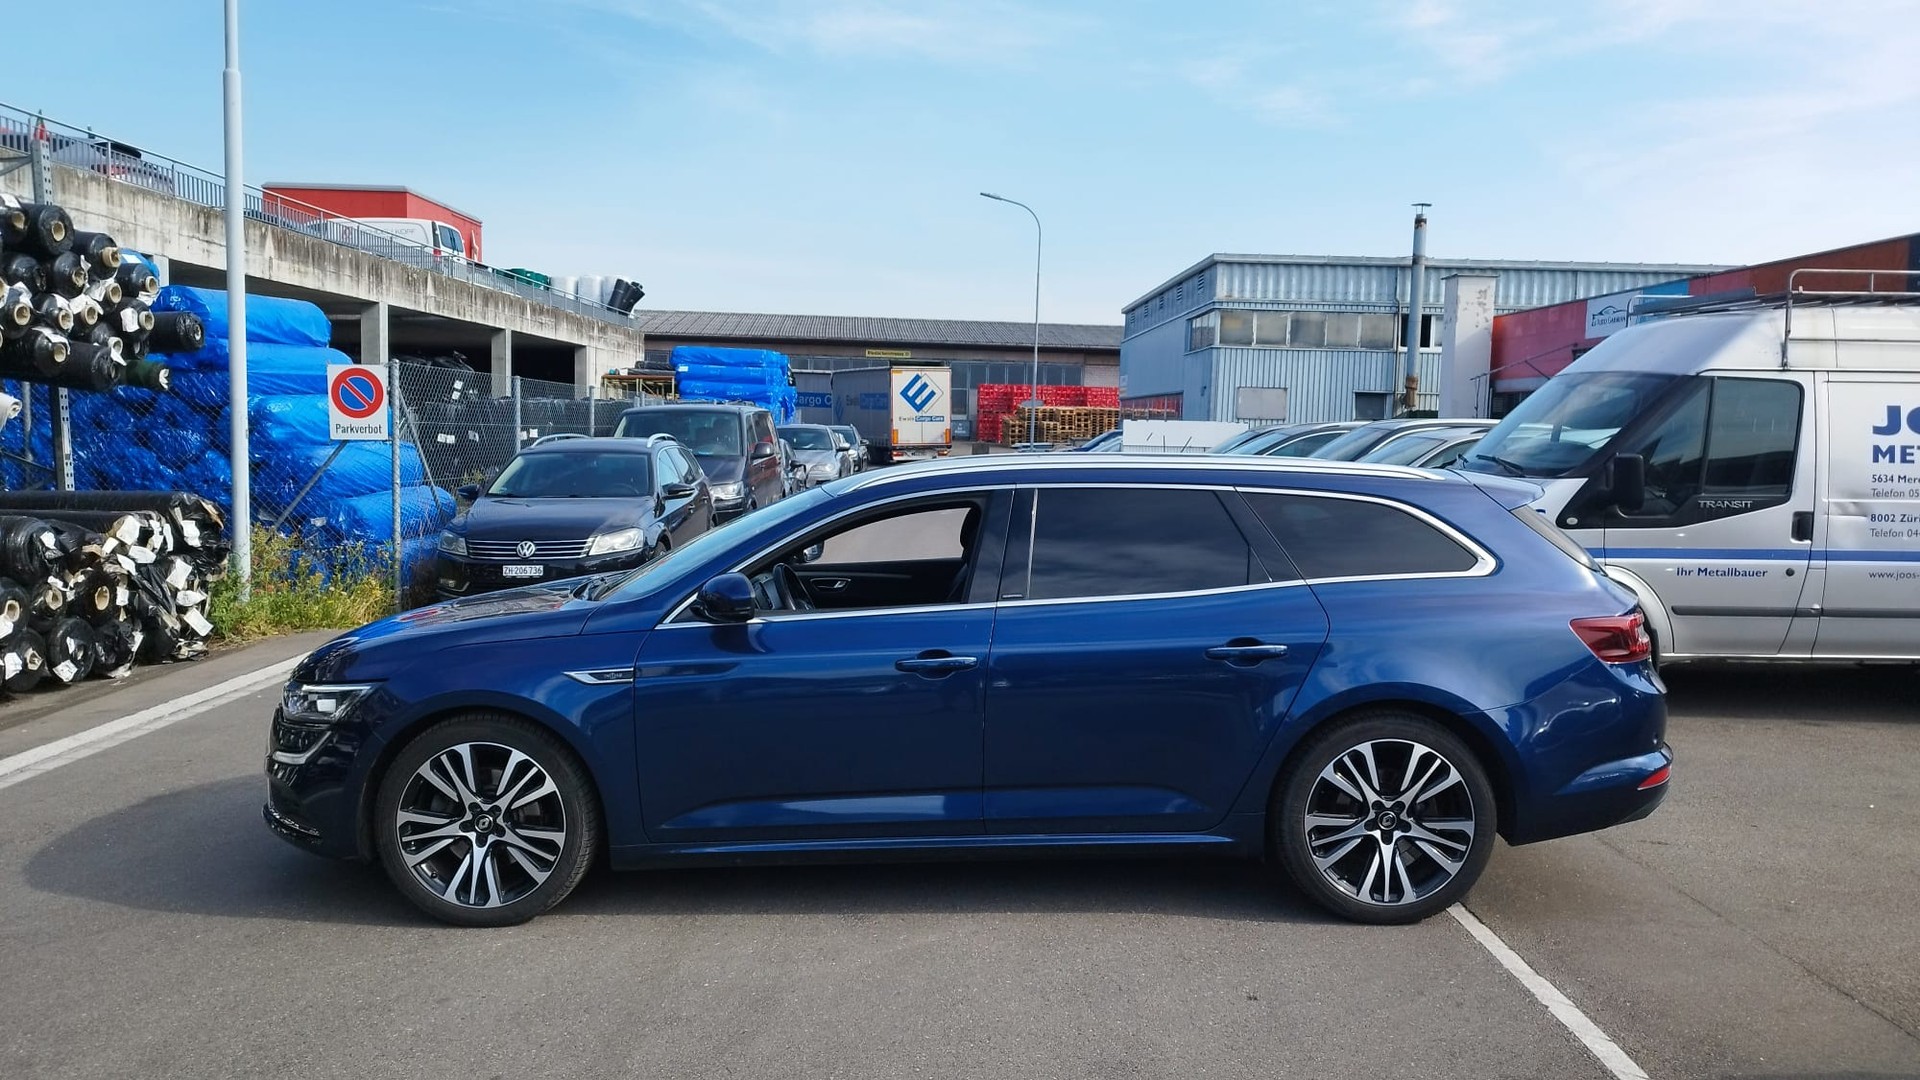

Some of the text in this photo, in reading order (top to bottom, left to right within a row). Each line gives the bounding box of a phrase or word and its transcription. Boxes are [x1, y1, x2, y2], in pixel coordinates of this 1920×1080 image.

[335, 423, 382, 434] Parkverbot
[1871, 474, 1894, 483] 5634
[1871, 488, 1905, 497] Telefon
[1698, 500, 1753, 509] TRANSIT
[1870, 513, 1896, 523] 8002
[1870, 528, 1920, 538] Telefon 04
[1676, 567, 1768, 577] Ihr Metallbauer
